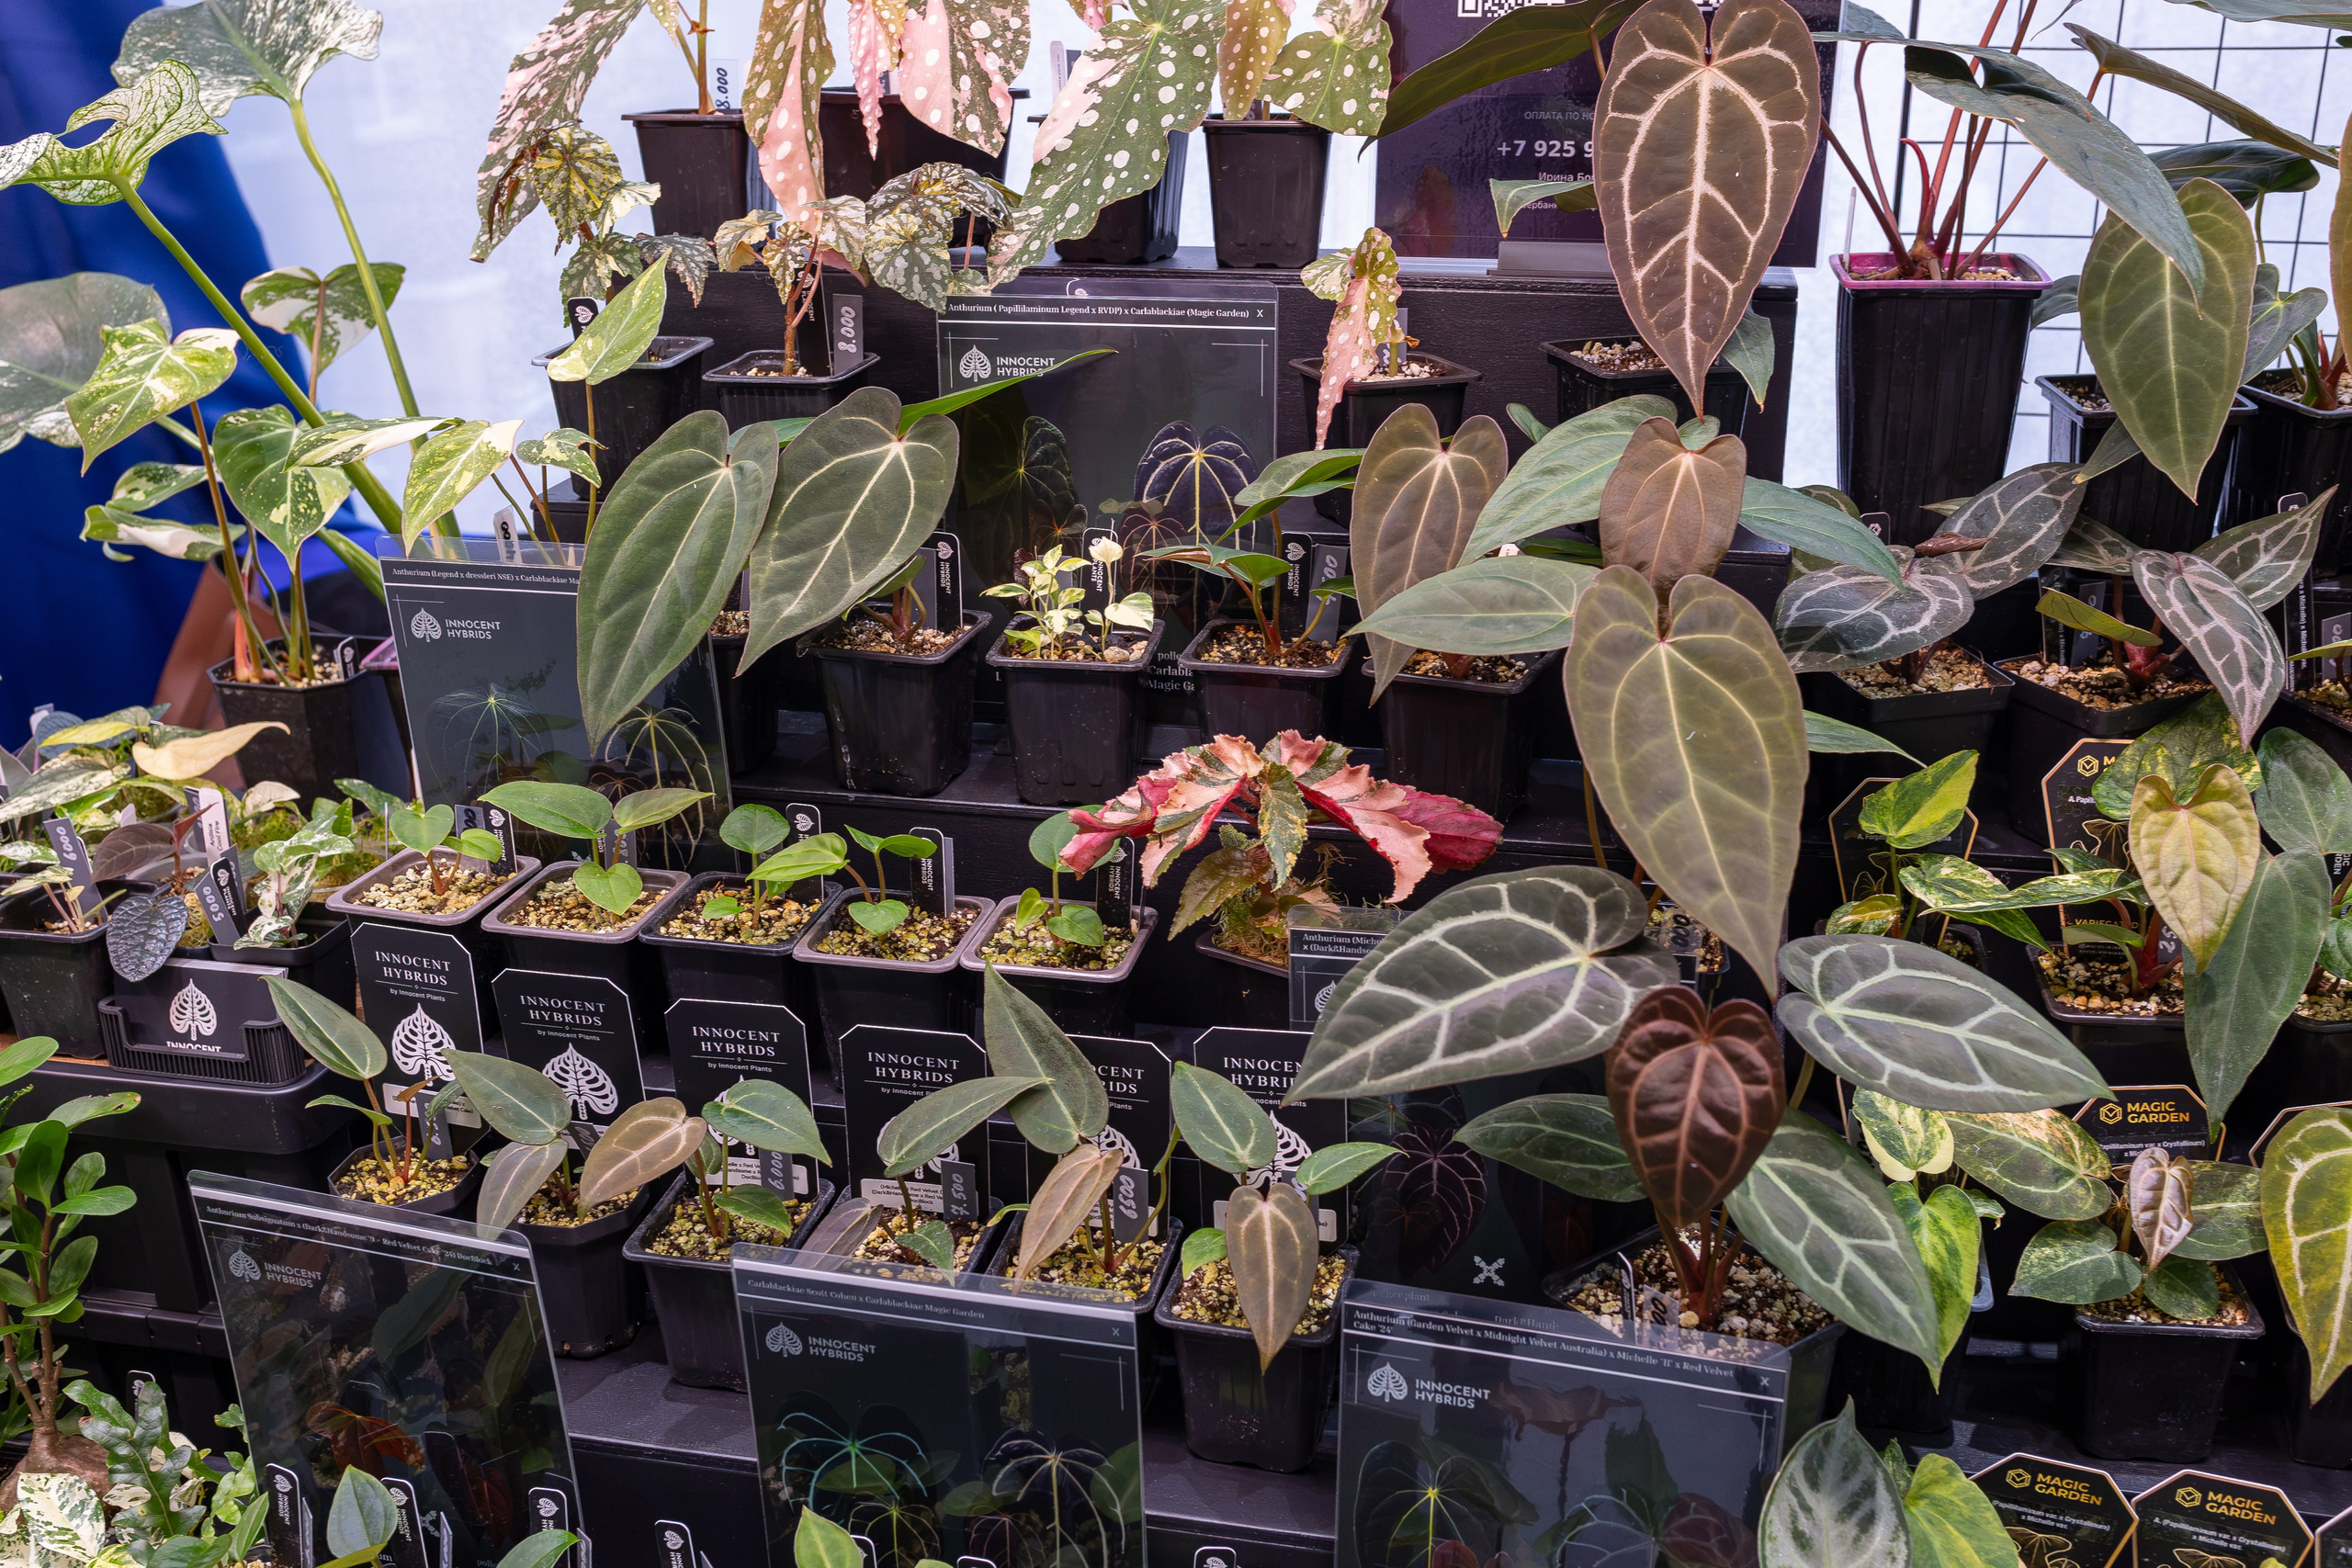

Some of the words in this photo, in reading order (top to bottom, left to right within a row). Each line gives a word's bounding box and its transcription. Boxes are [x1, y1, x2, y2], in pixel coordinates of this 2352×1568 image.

[1524, 111, 1562, 120] ОПЛАТА
[1497, 141, 1526, 157] +7
[1533, 141, 1576, 157] 925
[948, 303, 992, 313] Anthurium
[1060, 306, 1090, 316] Legend
[1098, 306, 1123, 317] RVDP)
[1130, 307, 1185, 317] Carlablackiae
[1186, 308, 1215, 319] (Magic
[1216, 309, 1250, 320] Garden)
[837, 306, 857, 354] 8.000
[997, 356, 1056, 367] INNOCENT
[392, 568, 431, 577] Anthurium
[431, 570, 458, 580] (Legend
[465, 571, 496, 581] dressleri
[520, 574, 568, 585] Carlablackiae
[1096, 560, 1104, 592] NNOCENT
[445, 619, 501, 631] INNOCENT
[447, 629, 492, 640] HYBRIDS
[55, 826, 78, 862] 6000
[1114, 865, 1122, 899] INNOCENT
[202, 886, 225, 922] 5000
[1303, 933, 1351, 944] Anthurium
[375, 951, 451, 972] INNOCENT
[382, 966, 448, 987] HYBRIDS
[390, 988, 399, 997] by
[400, 987, 425, 999] Innocent
[426, 992, 446, 1002] Plants
[520, 995, 605, 1013] INNOCENT
[529, 1010, 602, 1027] HYBRIDS
[537, 1029, 547, 1037] by
[548, 1030, 577, 1039] Innocent
[578, 1033, 601, 1042] Plants
[692, 1026, 780, 1043] INNOCENT
[701, 1041, 775, 1057] HYBRIDS
[718, 1063, 749, 1071] Innocent
[750, 1065, 773, 1073] Plants
[867, 1052, 960, 1070] INNOCENT
[876, 1066, 954, 1084] HYBRIDS
[892, 1088, 924, 1097] Innocent
[2127, 1101, 2176, 1112] MAGIC
[2127, 1112, 2190, 1123] GARDEN
[767, 1151, 786, 1190] 6.000
[1118, 1175, 1138, 1219] 6500
[206, 1205, 246, 1219] Anthurium
[246, 1212, 296, 1228] Subsignatum
[264, 1261, 322, 1281] INNOCENT
[266, 1271, 314, 1288] HYBRIDS
[748, 1279, 805, 1294] Carlablackiae
[806, 1288, 829, 1298] Scott
[865, 1295, 923, 1311] Carlablackiae
[924, 1303, 951, 1315] Magic
[952, 1307, 985, 1319] Garden
[1353, 1320, 1376, 1331] Cake
[808, 1336, 876, 1354] INNOCENT
[1353, 1309, 1407, 1325] Anthurium
[1407, 1318, 1444, 1333] (Garden
[1445, 1324, 1475, 1337] Velvet
[1483, 1329, 1527, 1346] Midnight
[1528, 1337, 1558, 1349] Velvet
[1559, 1342, 1608, 1358] Australia)
[1616, 1350, 1658, 1365] Michelle
[1682, 1360, 1702, 1372] Red
[1702, 1364, 1735, 1378] Velvet
[809, 1346, 865, 1362] HYBRIDS
[1415, 1379, 1491, 1401] INNOCENT
[1415, 1391, 1476, 1409] HYBRIDS
[2037, 1472, 2090, 1493] MAGIC
[2034, 1483, 2103, 1506] GARDEN
[2207, 1491, 2264, 1511] MAGIC
[2205, 1502, 2277, 1526] GARDEN
[401, 1508, 412, 1542] INNOCENT
